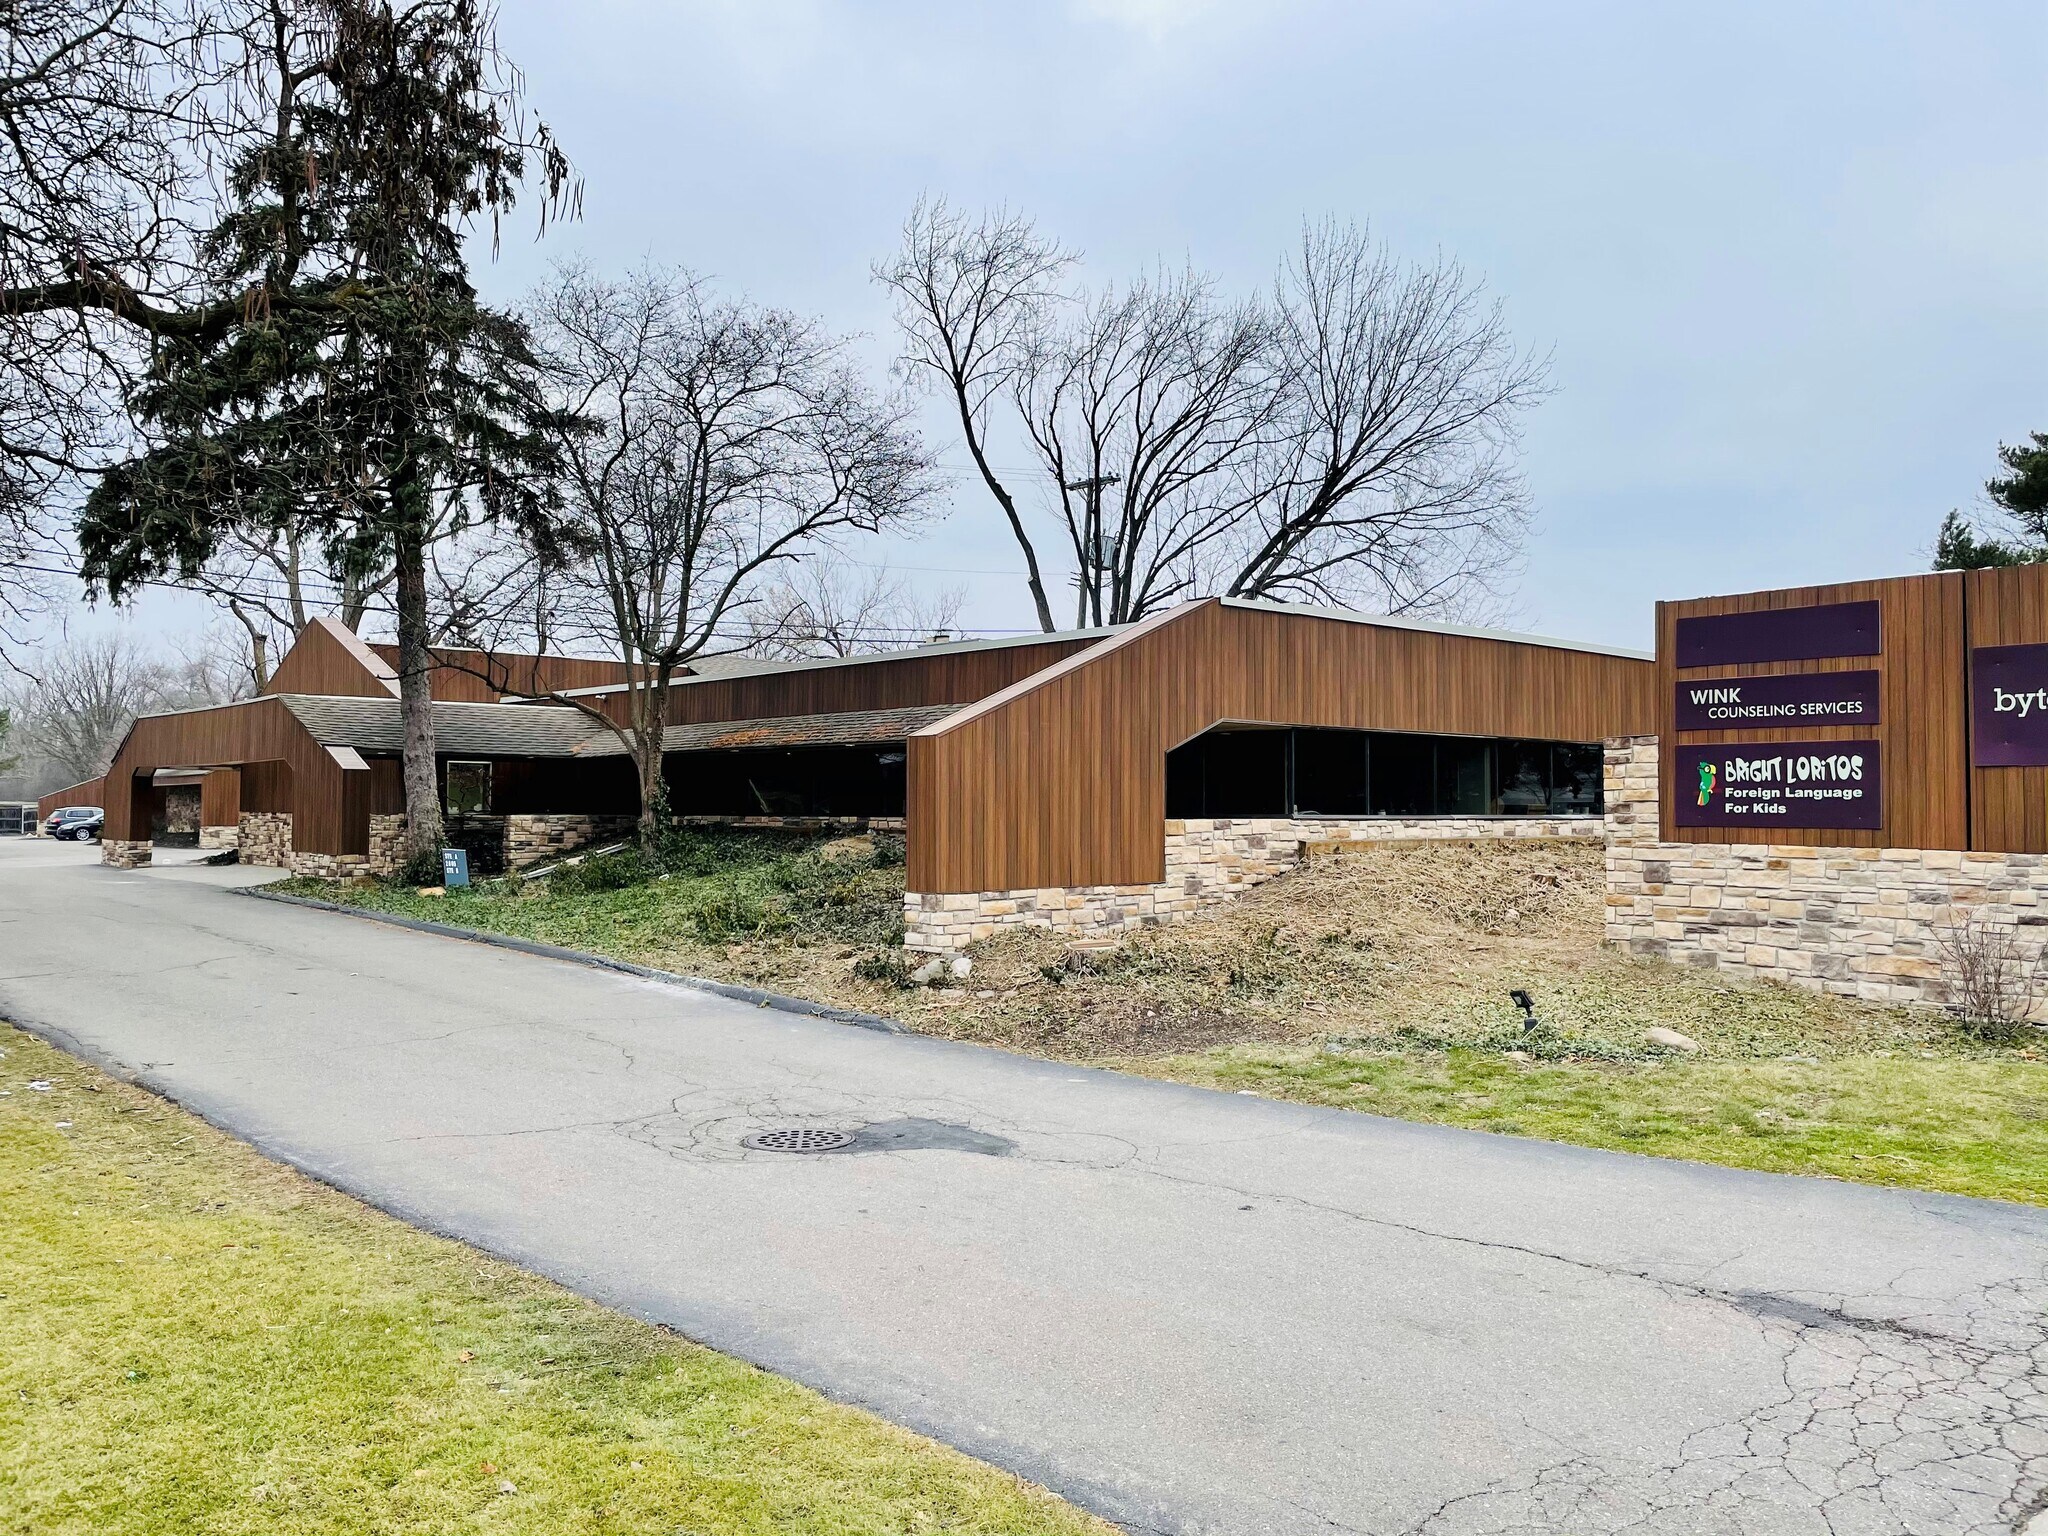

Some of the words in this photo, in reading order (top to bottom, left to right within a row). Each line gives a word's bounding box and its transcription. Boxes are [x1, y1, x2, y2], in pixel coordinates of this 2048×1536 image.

[1690, 688, 1741, 704] WINK
[1993, 687, 2048, 718] byt
[1708, 704, 1796, 718] COUNSELING
[1800, 701, 1863, 715] SERVICES
[1725, 787, 1780, 800] Foreign
[1785, 787, 1863, 800] Language
[1725, 803, 1749, 814] For
[1753, 803, 1787, 814] Kids
